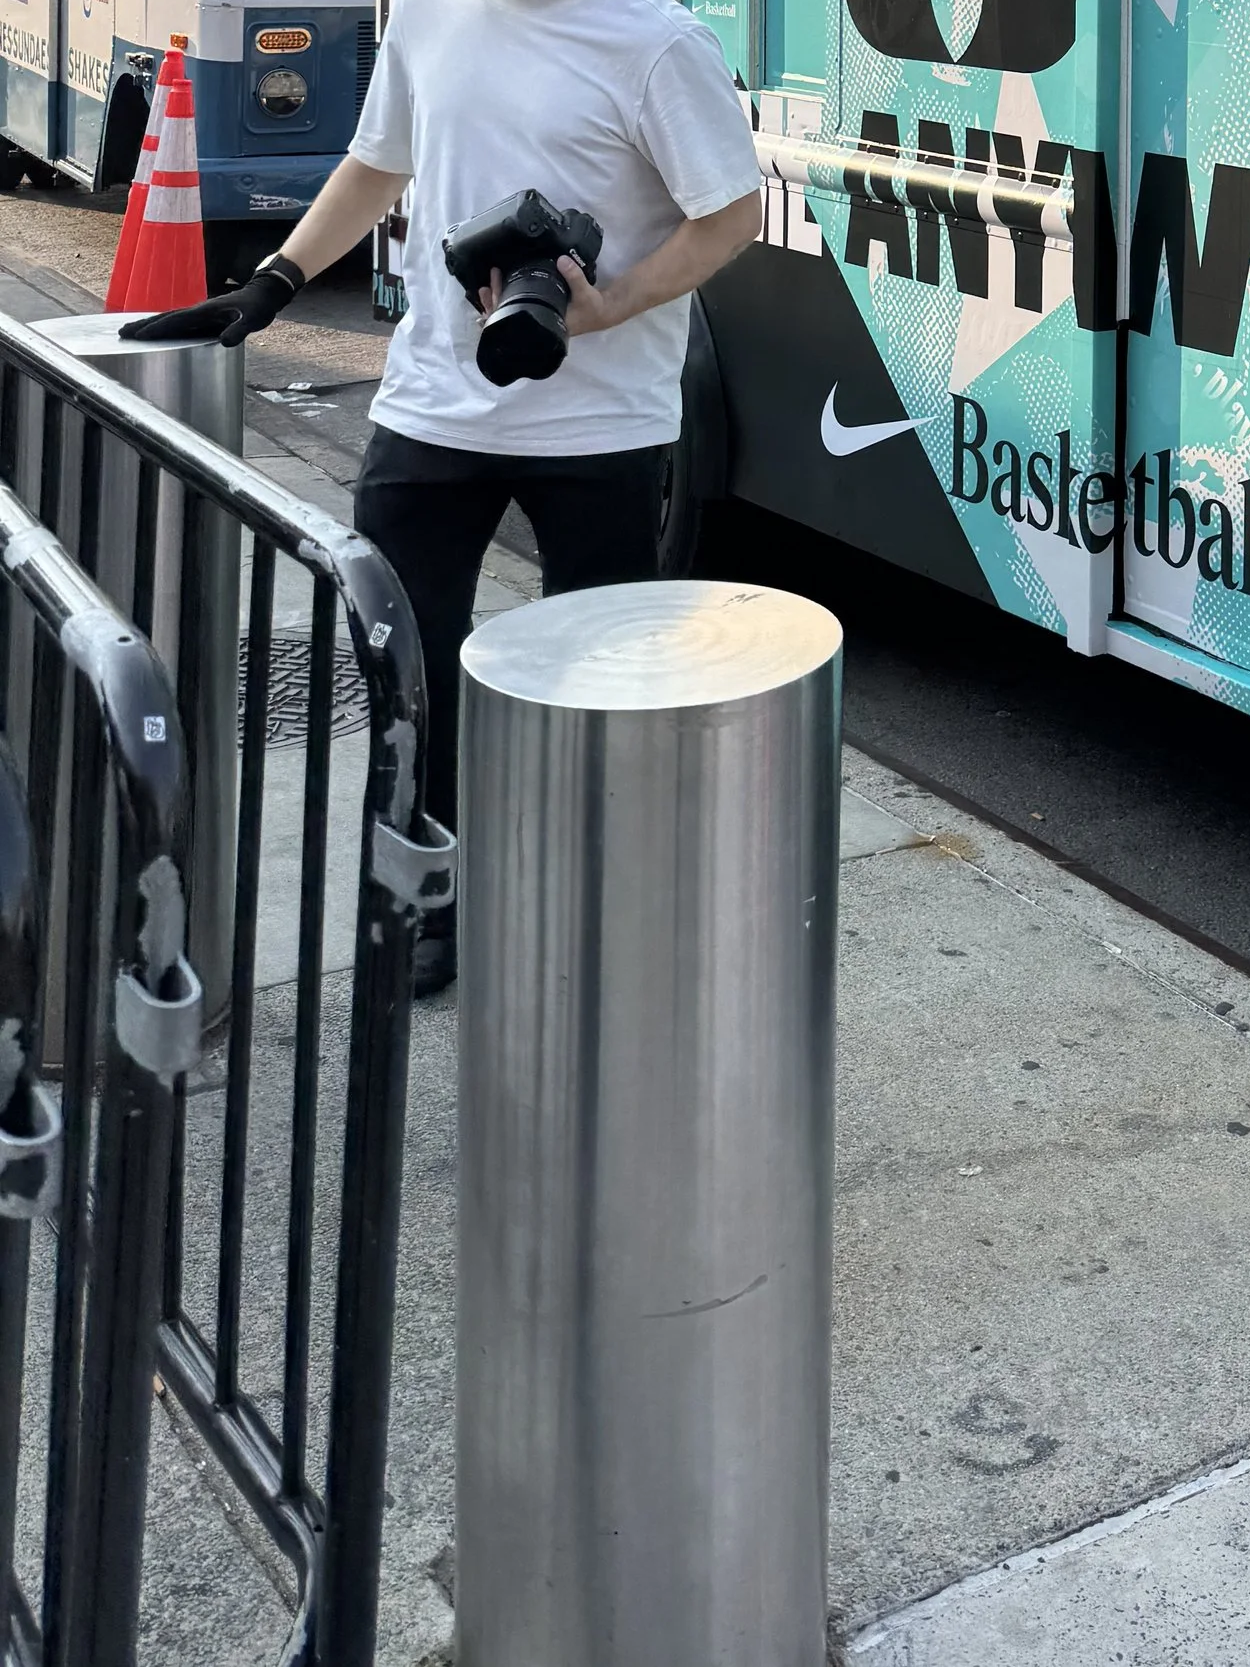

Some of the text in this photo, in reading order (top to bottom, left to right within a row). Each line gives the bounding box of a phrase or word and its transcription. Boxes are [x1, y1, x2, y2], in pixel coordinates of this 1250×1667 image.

[705, 0, 736, 18] Basketball
[13, 26, 50, 70] SUNDAE
[69, 46, 109, 98] SHAKES
